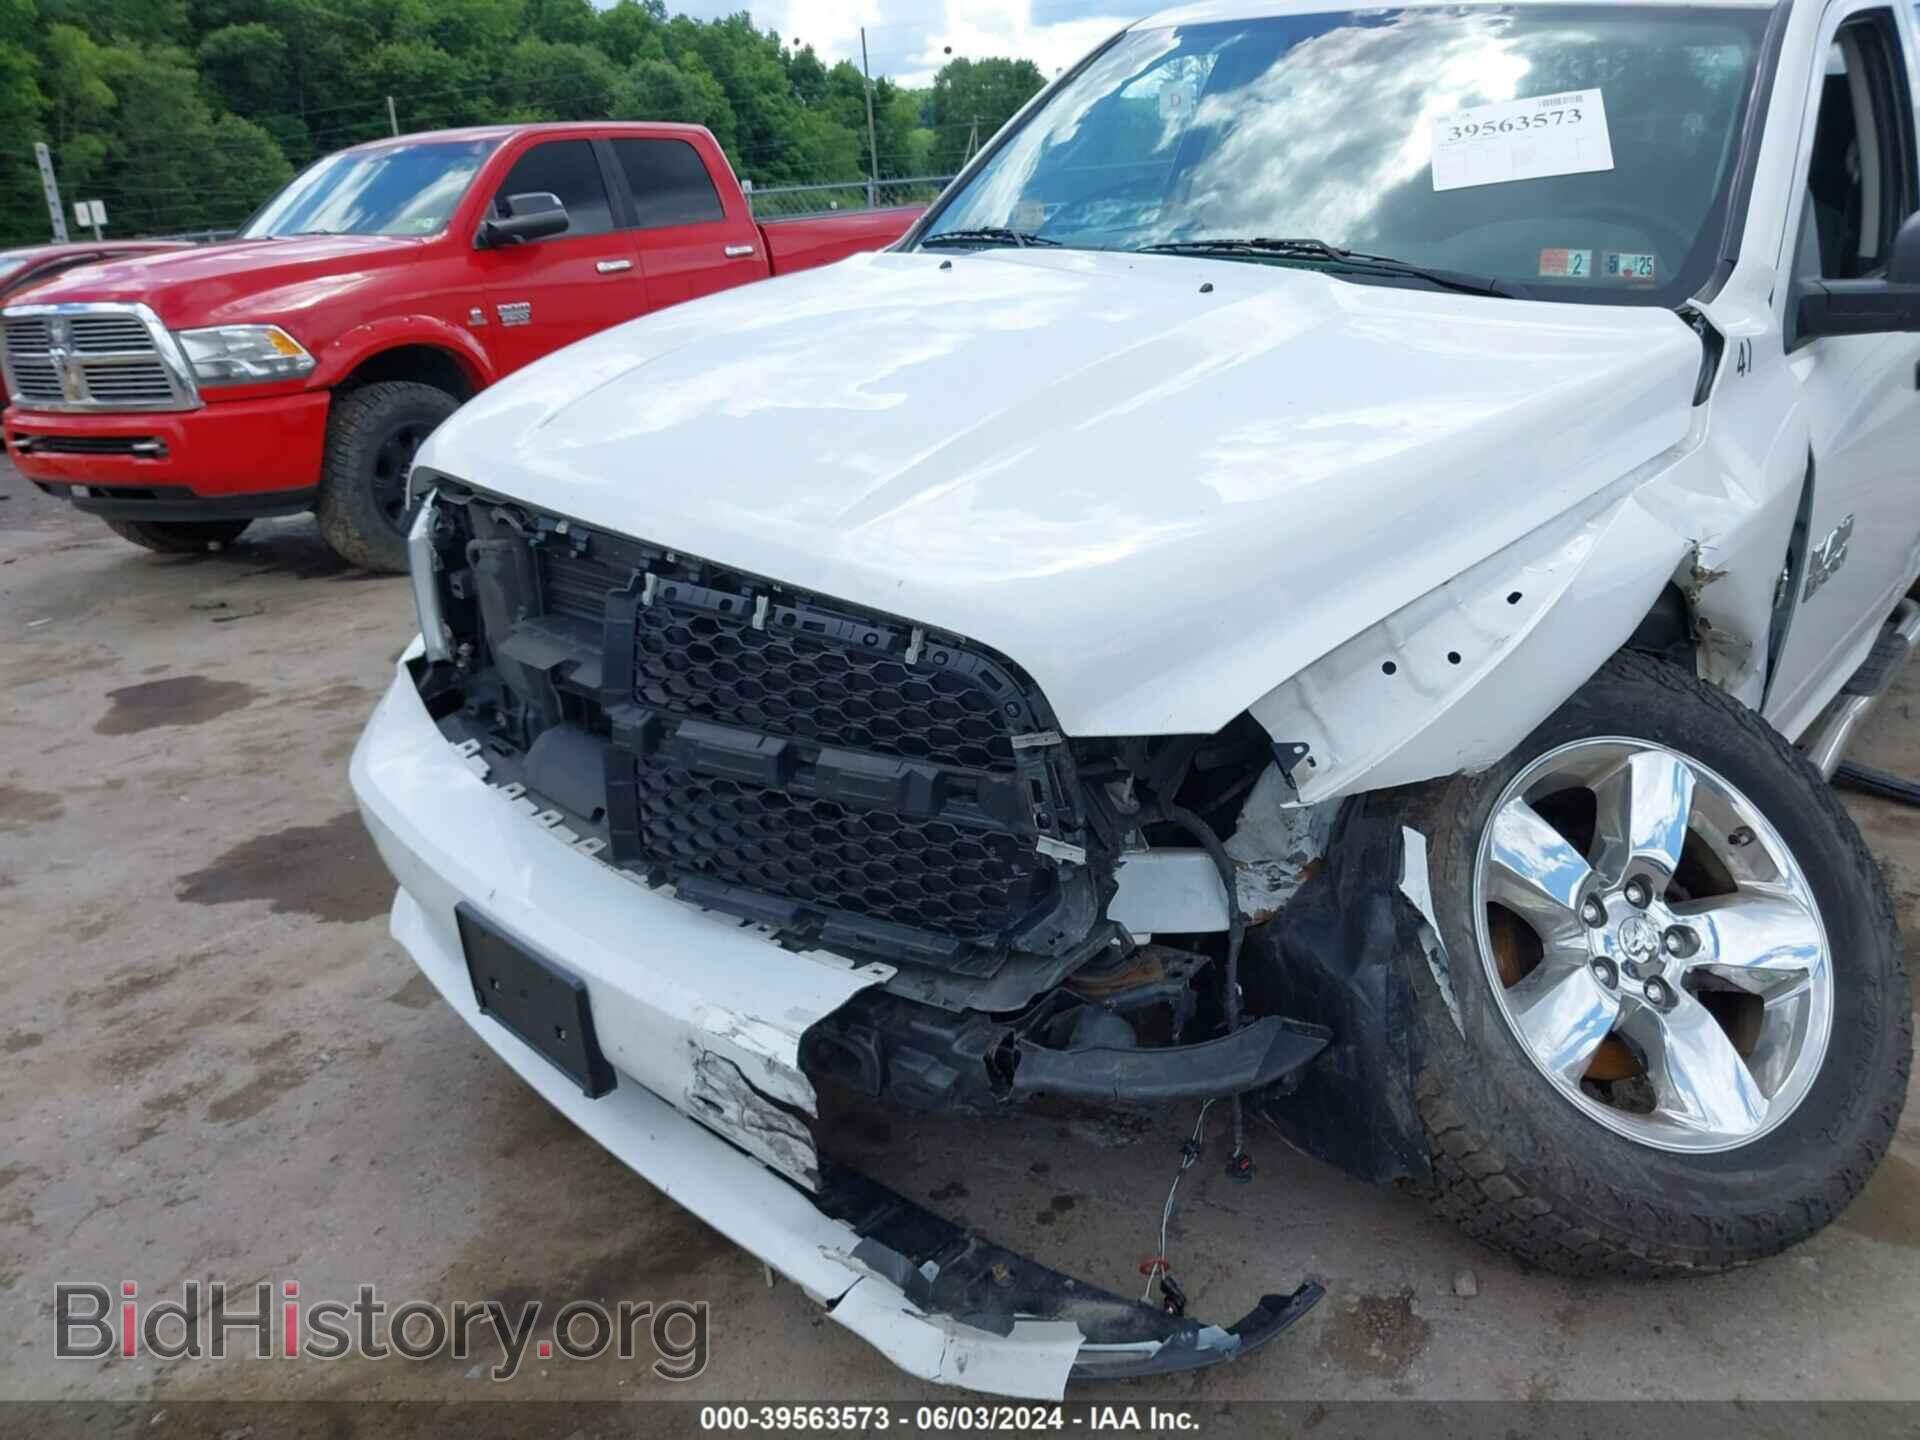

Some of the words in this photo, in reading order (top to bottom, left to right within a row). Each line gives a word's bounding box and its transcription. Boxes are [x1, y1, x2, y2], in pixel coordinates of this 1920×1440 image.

[1447, 108, 1583, 141] 39563573
[1571, 253, 1583, 275] 2
[1639, 256, 1653, 276] 25
